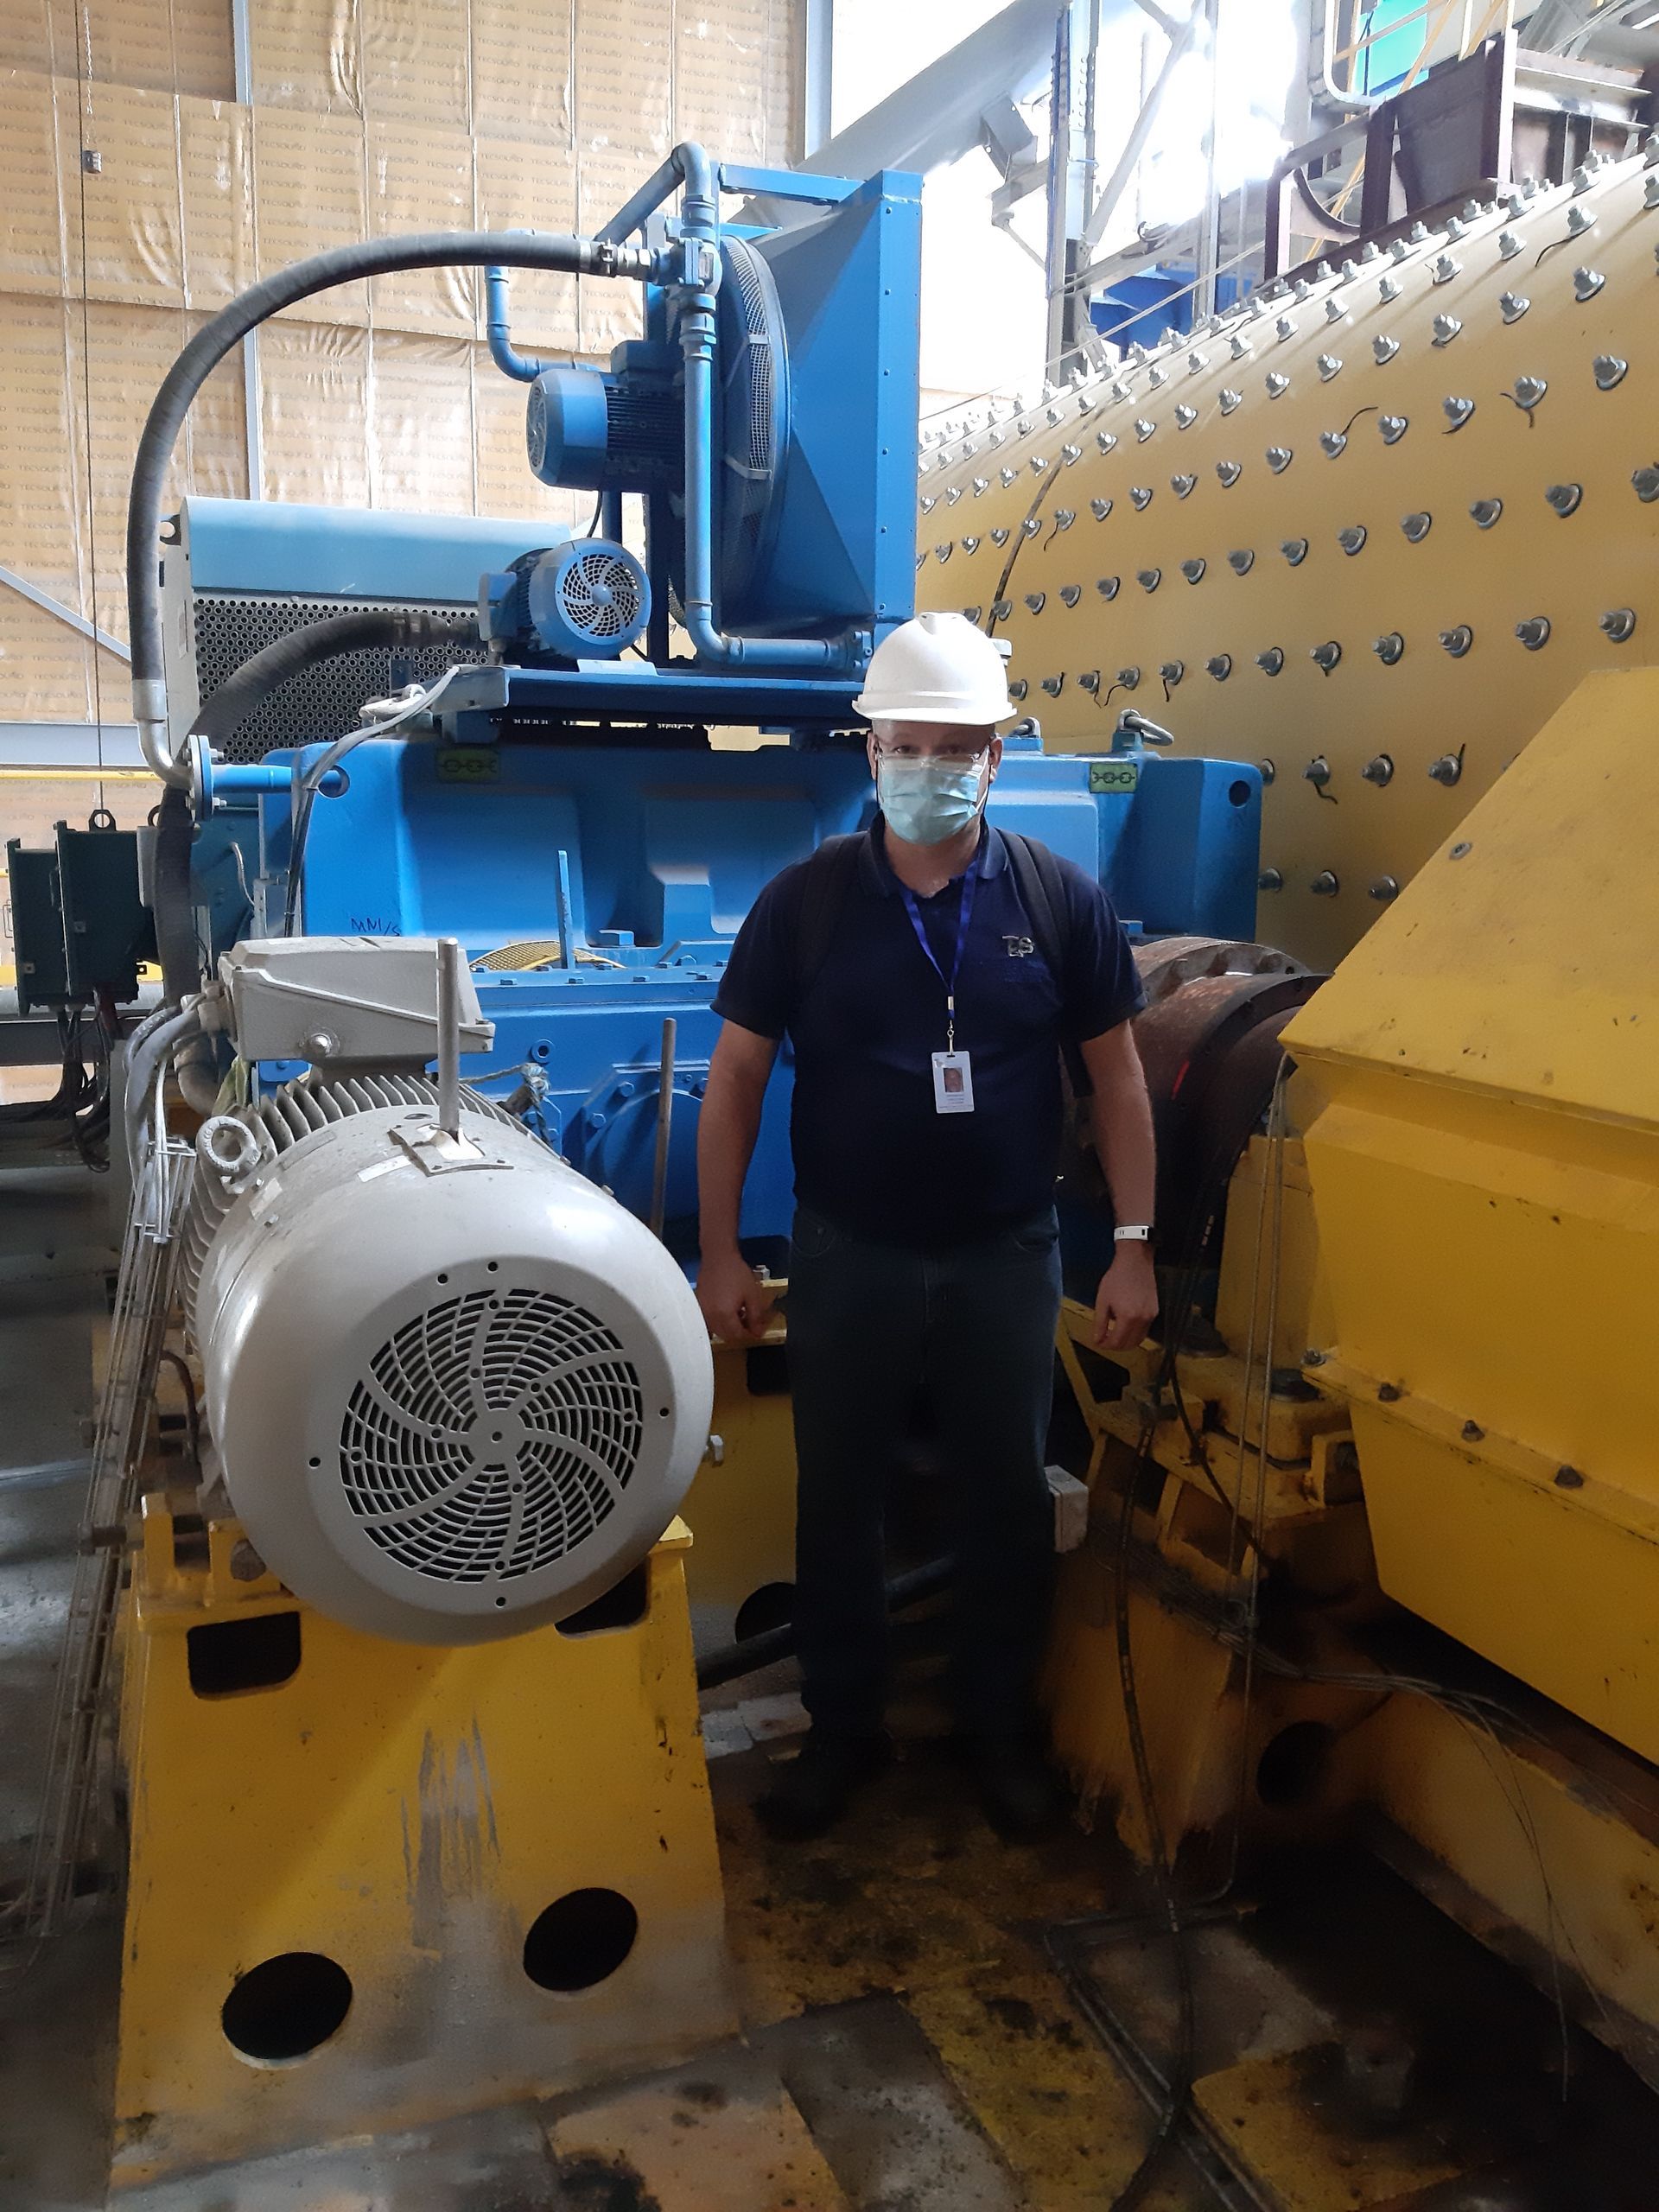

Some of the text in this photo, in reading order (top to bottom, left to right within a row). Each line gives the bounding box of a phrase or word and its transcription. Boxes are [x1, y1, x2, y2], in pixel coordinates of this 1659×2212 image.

[420, 3, 464, 13] TECSOUND
[476, 0, 569, 19] TECSOUND TECSOUND
[629, 1, 669, 11] TECSOUND
[581, 10, 669, 29] TECSOUND TECSOUND
[680, 14, 720, 26] TECSOUND
[421, 22, 465, 32] TECSOUND
[477, 19, 569, 37] TECSOUND TECSOUND
[581, 29, 622, 40] TECSOUND
[118, 39, 168, 51] TECSOUND
[422, 41, 465, 51] TECSOUND
[477, 37, 569, 56] TECSOUND TECSOUND
[581, 48, 669, 66] TECSOUND TECSOUND
[680, 50, 720, 61] TECSOUND
[119, 60, 169, 71] TECSOUND
[258, 64, 304, 73] TECSOUND
[477, 56, 569, 74] TECSOUND TECSOUND
[581, 66, 622, 76] TECSOUND
[680, 68, 720, 79] TECSOUND
[478, 75, 520, 86] TECSOUND
[581, 84, 621, 94] TECSOUND
[680, 86, 719, 97] TECSOUND
[371, 91, 416, 101] TECSOUND
[478, 93, 520, 105] TECSOUND
[260, 103, 307, 111] TECSOUND
[581, 102, 622, 112] TECSOUND
[680, 105, 719, 115] TECSOUND
[371, 110, 416, 119] TECSOUND
[478, 112, 520, 123] TECSOUND
[124, 119, 172, 130] TECSOUND
[259, 121, 359, 137] TECSOUND TECSOUND
[581, 121, 622, 130] TECSOUND
[680, 123, 719, 132] TECSOUND
[478, 131, 521, 141] TECSOUND
[124, 140, 173, 150] TECSOUND
[259, 141, 306, 150] TECSOUND
[373, 136, 470, 151] TECSOUND TECSOUND
[124, 160, 173, 170] TECSOUND
[480, 153, 573, 168] TECSOUND TECSOUND
[2, 166, 53, 175] TECSOUND
[260, 160, 359, 176] TECSOUND TECSOUND
[584, 161, 626, 171] TECSOUND
[125, 180, 175, 190] TECSOUND
[261, 180, 360, 195] TECSOUND TECSOUND
[426, 180, 470, 190] TECSOUND
[531, 178, 573, 188] TECSOUND
[584, 180, 626, 189] TECSOUND
[3, 187, 54, 196] TECSOUND
[374, 193, 419, 202] TECSOUND
[531, 197, 573, 206] TECSOUND
[315, 205, 361, 214] TECSOUND
[188, 211, 237, 221] TECSOUND
[532, 215, 574, 224] TECSOUND
[262, 219, 308, 228] TECSOUND
[427, 219, 470, 227] TECSOUND
[263, 238, 308, 247] TECSOUND
[190, 251, 238, 260] TECSOUND
[378, 288, 422, 296] TECSOUND
[585, 290, 626, 299] TECSOUND
[130, 341, 178, 351] TECSOUND
